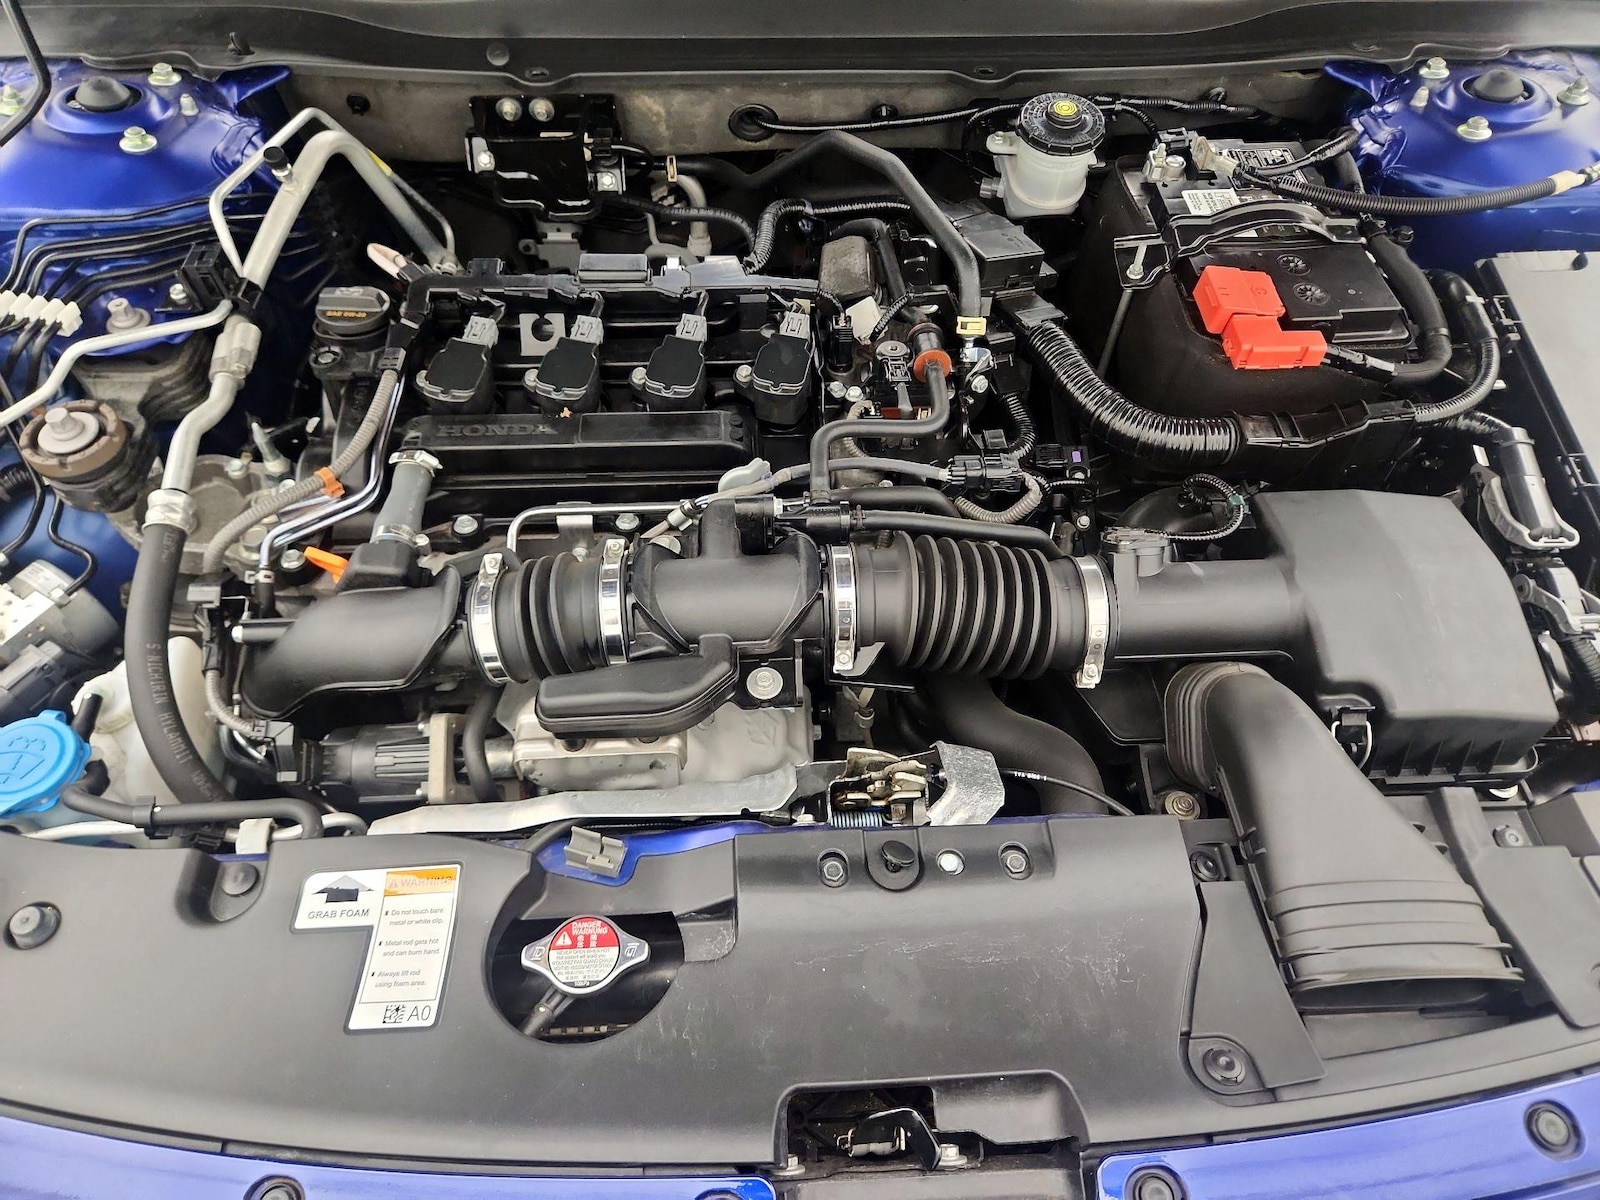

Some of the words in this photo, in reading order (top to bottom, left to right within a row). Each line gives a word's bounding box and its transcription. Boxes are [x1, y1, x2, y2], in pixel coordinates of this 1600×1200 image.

[436, 423, 558, 437] HONDA
[401, 875, 453, 888] WARNING
[307, 910, 337, 919] GRAB
[340, 908, 370, 918] FOAM
[572, 920, 602, 929] DANGER
[415, 938, 428, 947] gets
[377, 970, 400, 979] Always
[401, 969, 410, 977] lift
[410, 969, 421, 977] rod
[375, 980, 392, 989] using
